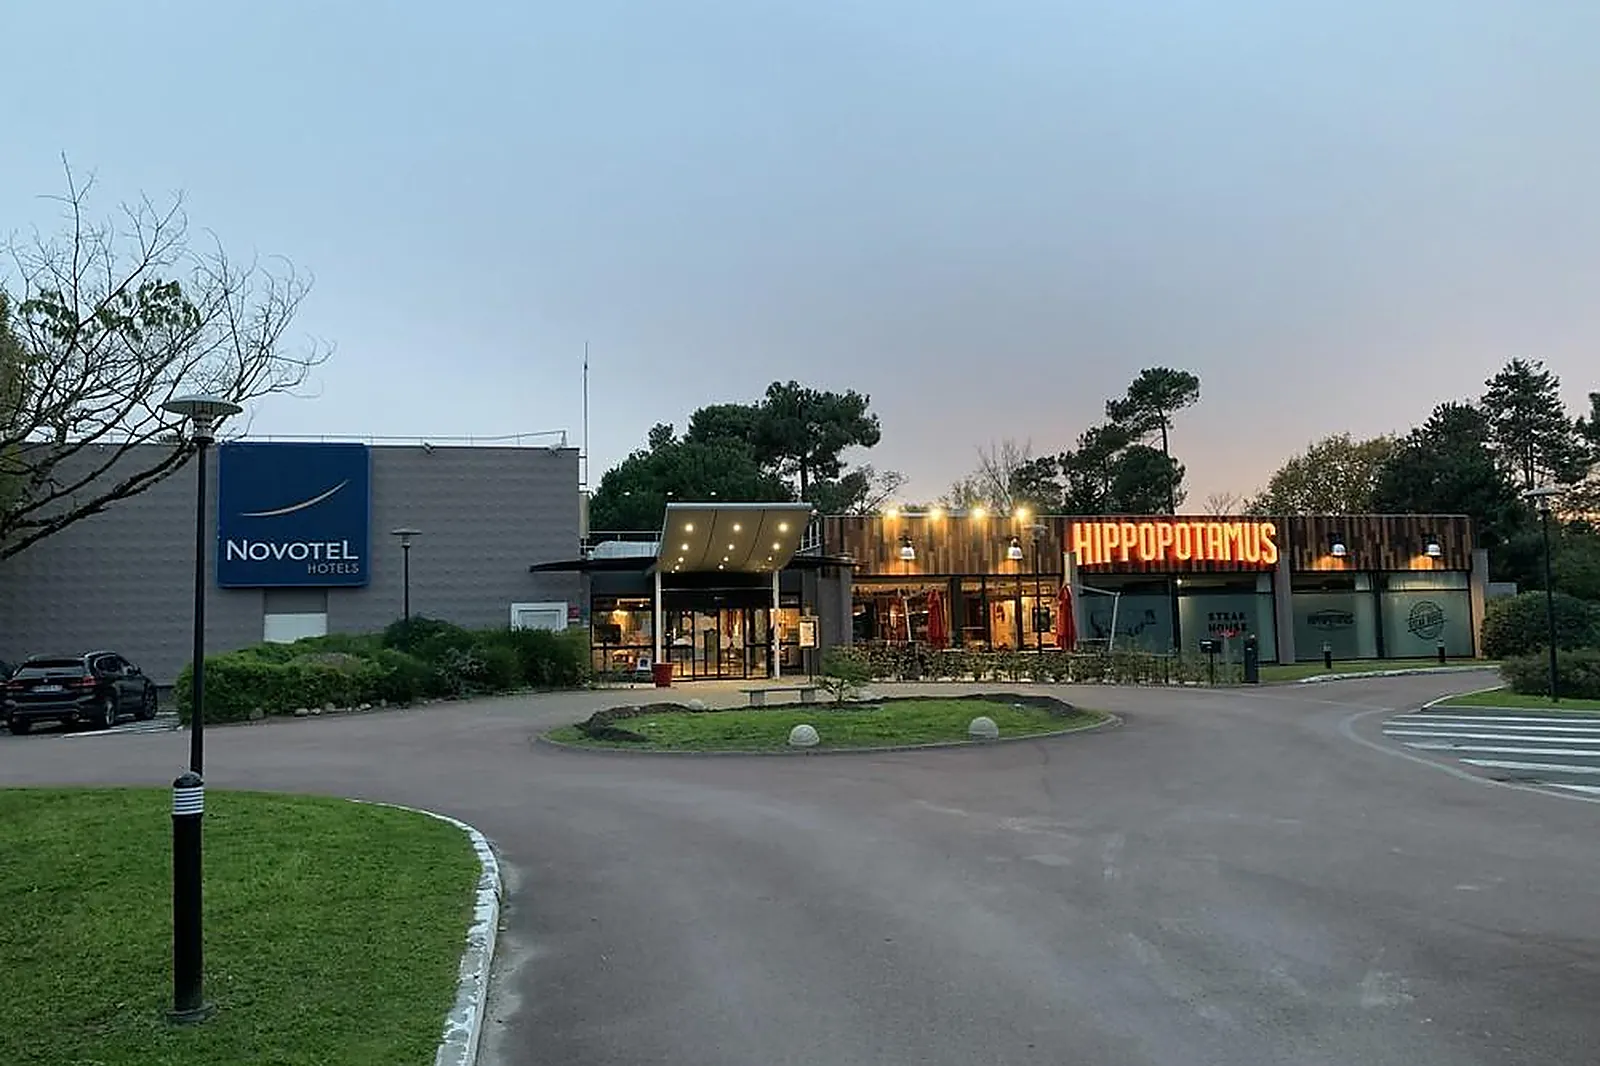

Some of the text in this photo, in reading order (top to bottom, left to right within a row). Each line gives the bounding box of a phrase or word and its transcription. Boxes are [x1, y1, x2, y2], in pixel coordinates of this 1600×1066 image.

[226, 539, 359, 561] NOVOTEL
[1073, 522, 1278, 565] HIPPOPOTAMUS
[307, 563, 359, 574] HOTELS
[1208, 623, 1247, 632] HOUSE
